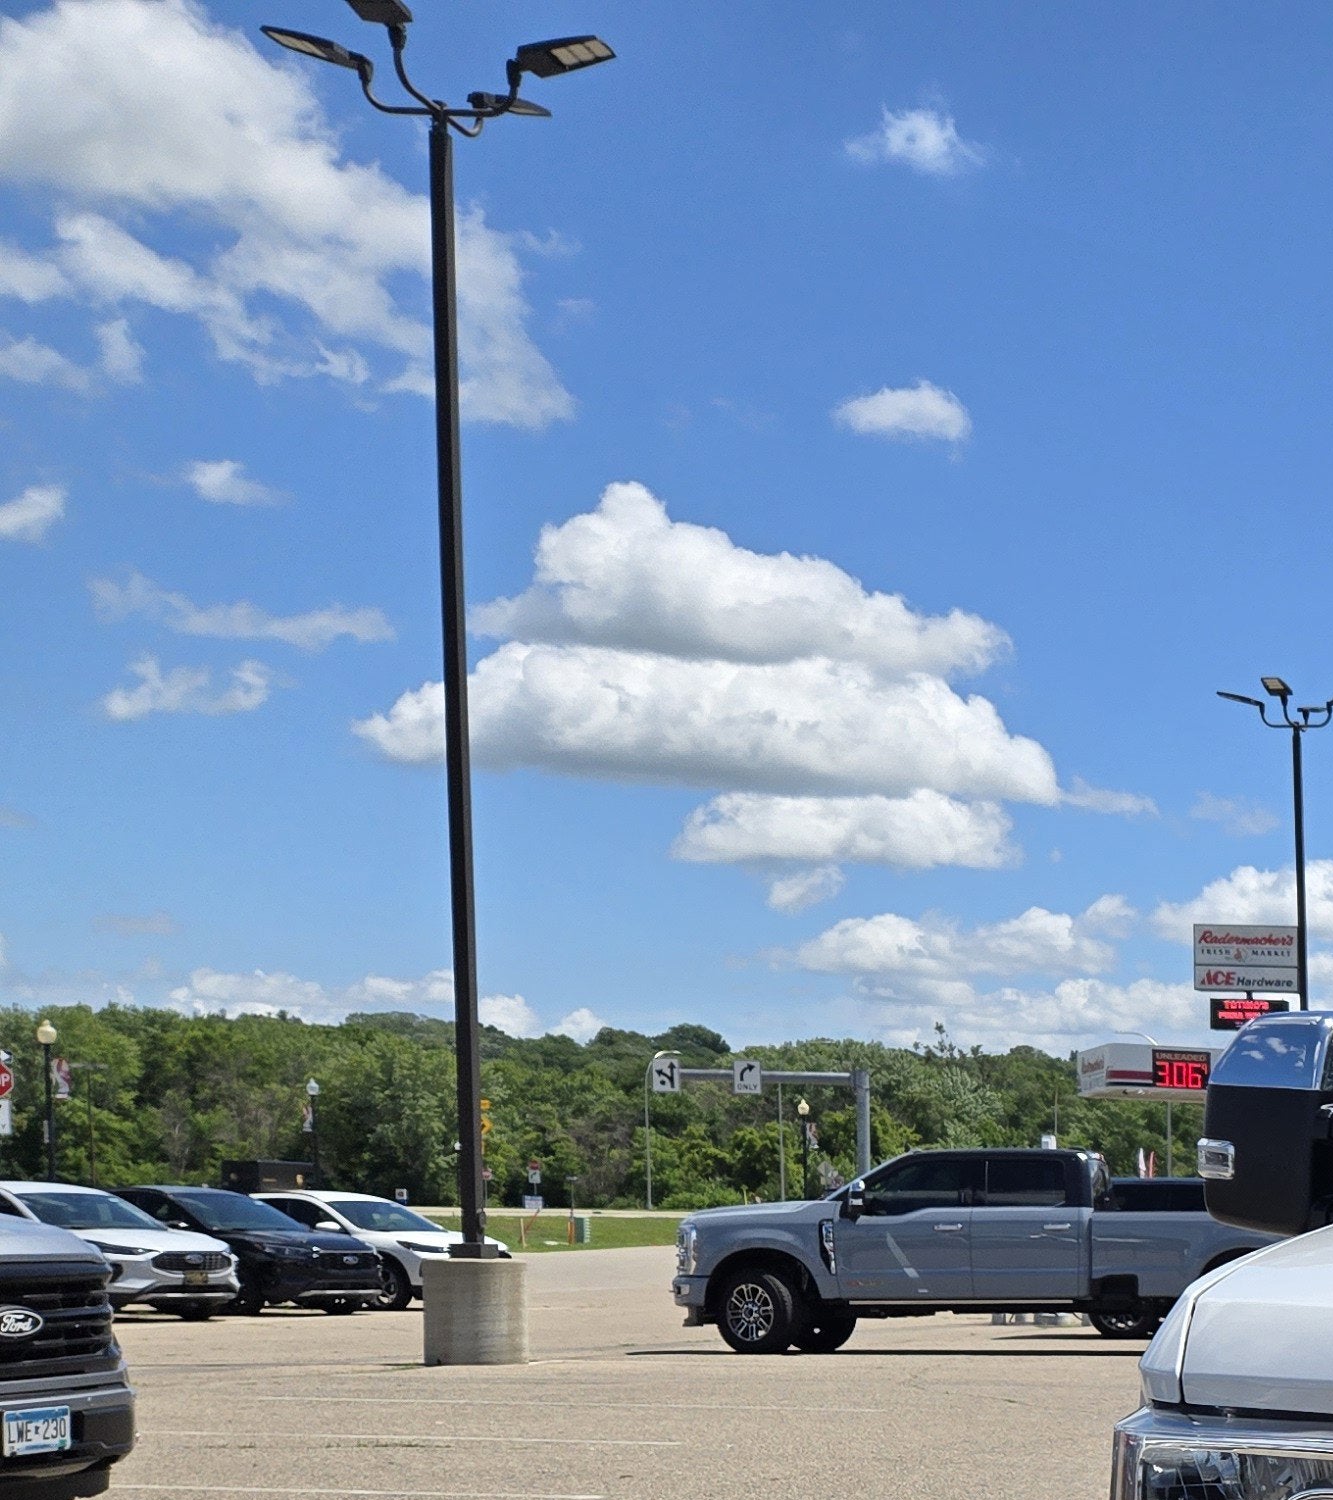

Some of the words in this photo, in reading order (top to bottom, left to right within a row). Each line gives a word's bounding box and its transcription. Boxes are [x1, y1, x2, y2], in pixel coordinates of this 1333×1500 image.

[1251, 949, 1291, 957] MARKET
[1200, 969, 1236, 986] ACE
[1236, 976, 1294, 987] Hardware
[1156, 1052, 1207, 1061] UNLEADED
[737, 1083, 758, 1091] ONLY
[1, 1314, 33, 1332] Ford
[8, 1420, 32, 1444] LWE
[42, 1418, 67, 1440] 230
